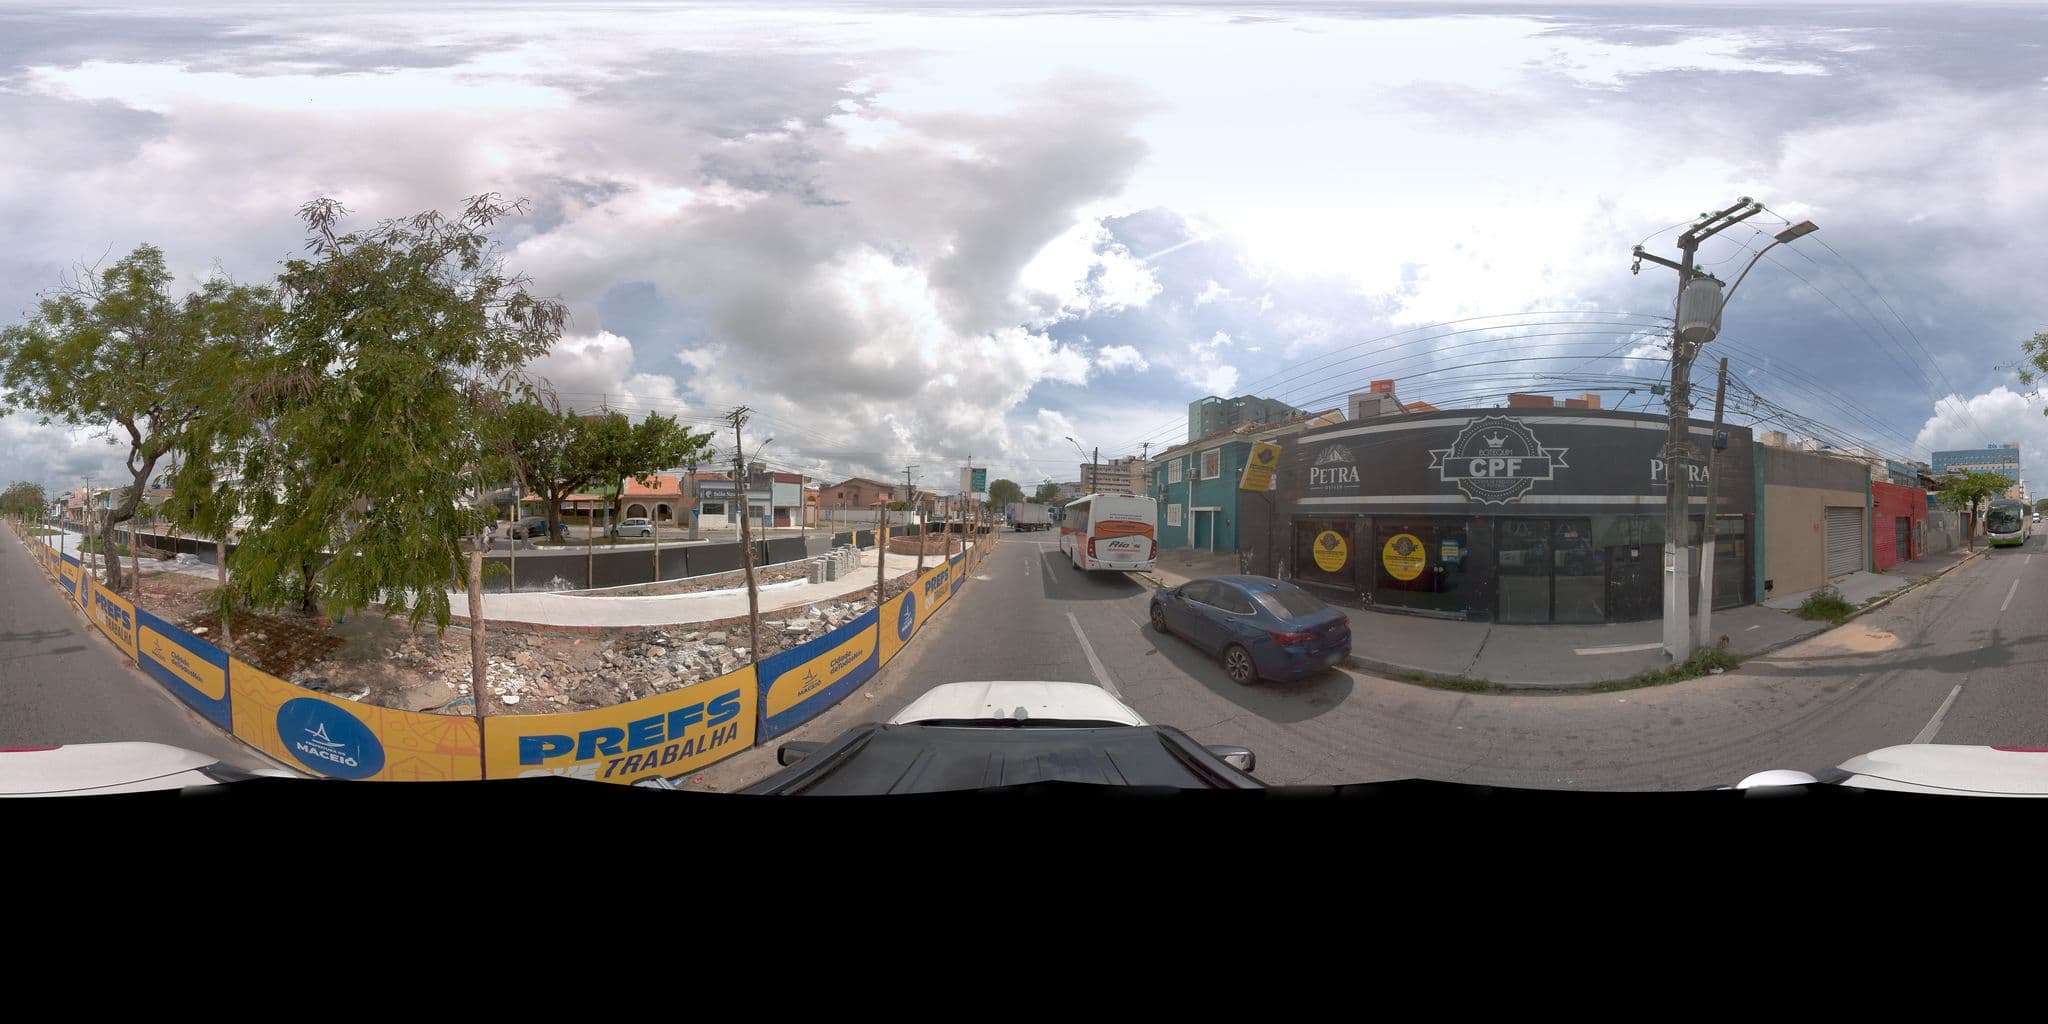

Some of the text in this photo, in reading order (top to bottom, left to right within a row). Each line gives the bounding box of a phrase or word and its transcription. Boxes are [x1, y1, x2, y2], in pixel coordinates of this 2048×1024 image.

[1309, 466, 1360, 485] PETRA
[1469, 457, 1522, 478] CPF
[1650, 458, 1710, 483] PRA
[94, 590, 132, 631] PREFS
[519, 689, 741, 766] PREFS
[296, 742, 358, 767] MACEIÓ
[603, 722, 738, 778] TRABALHA
